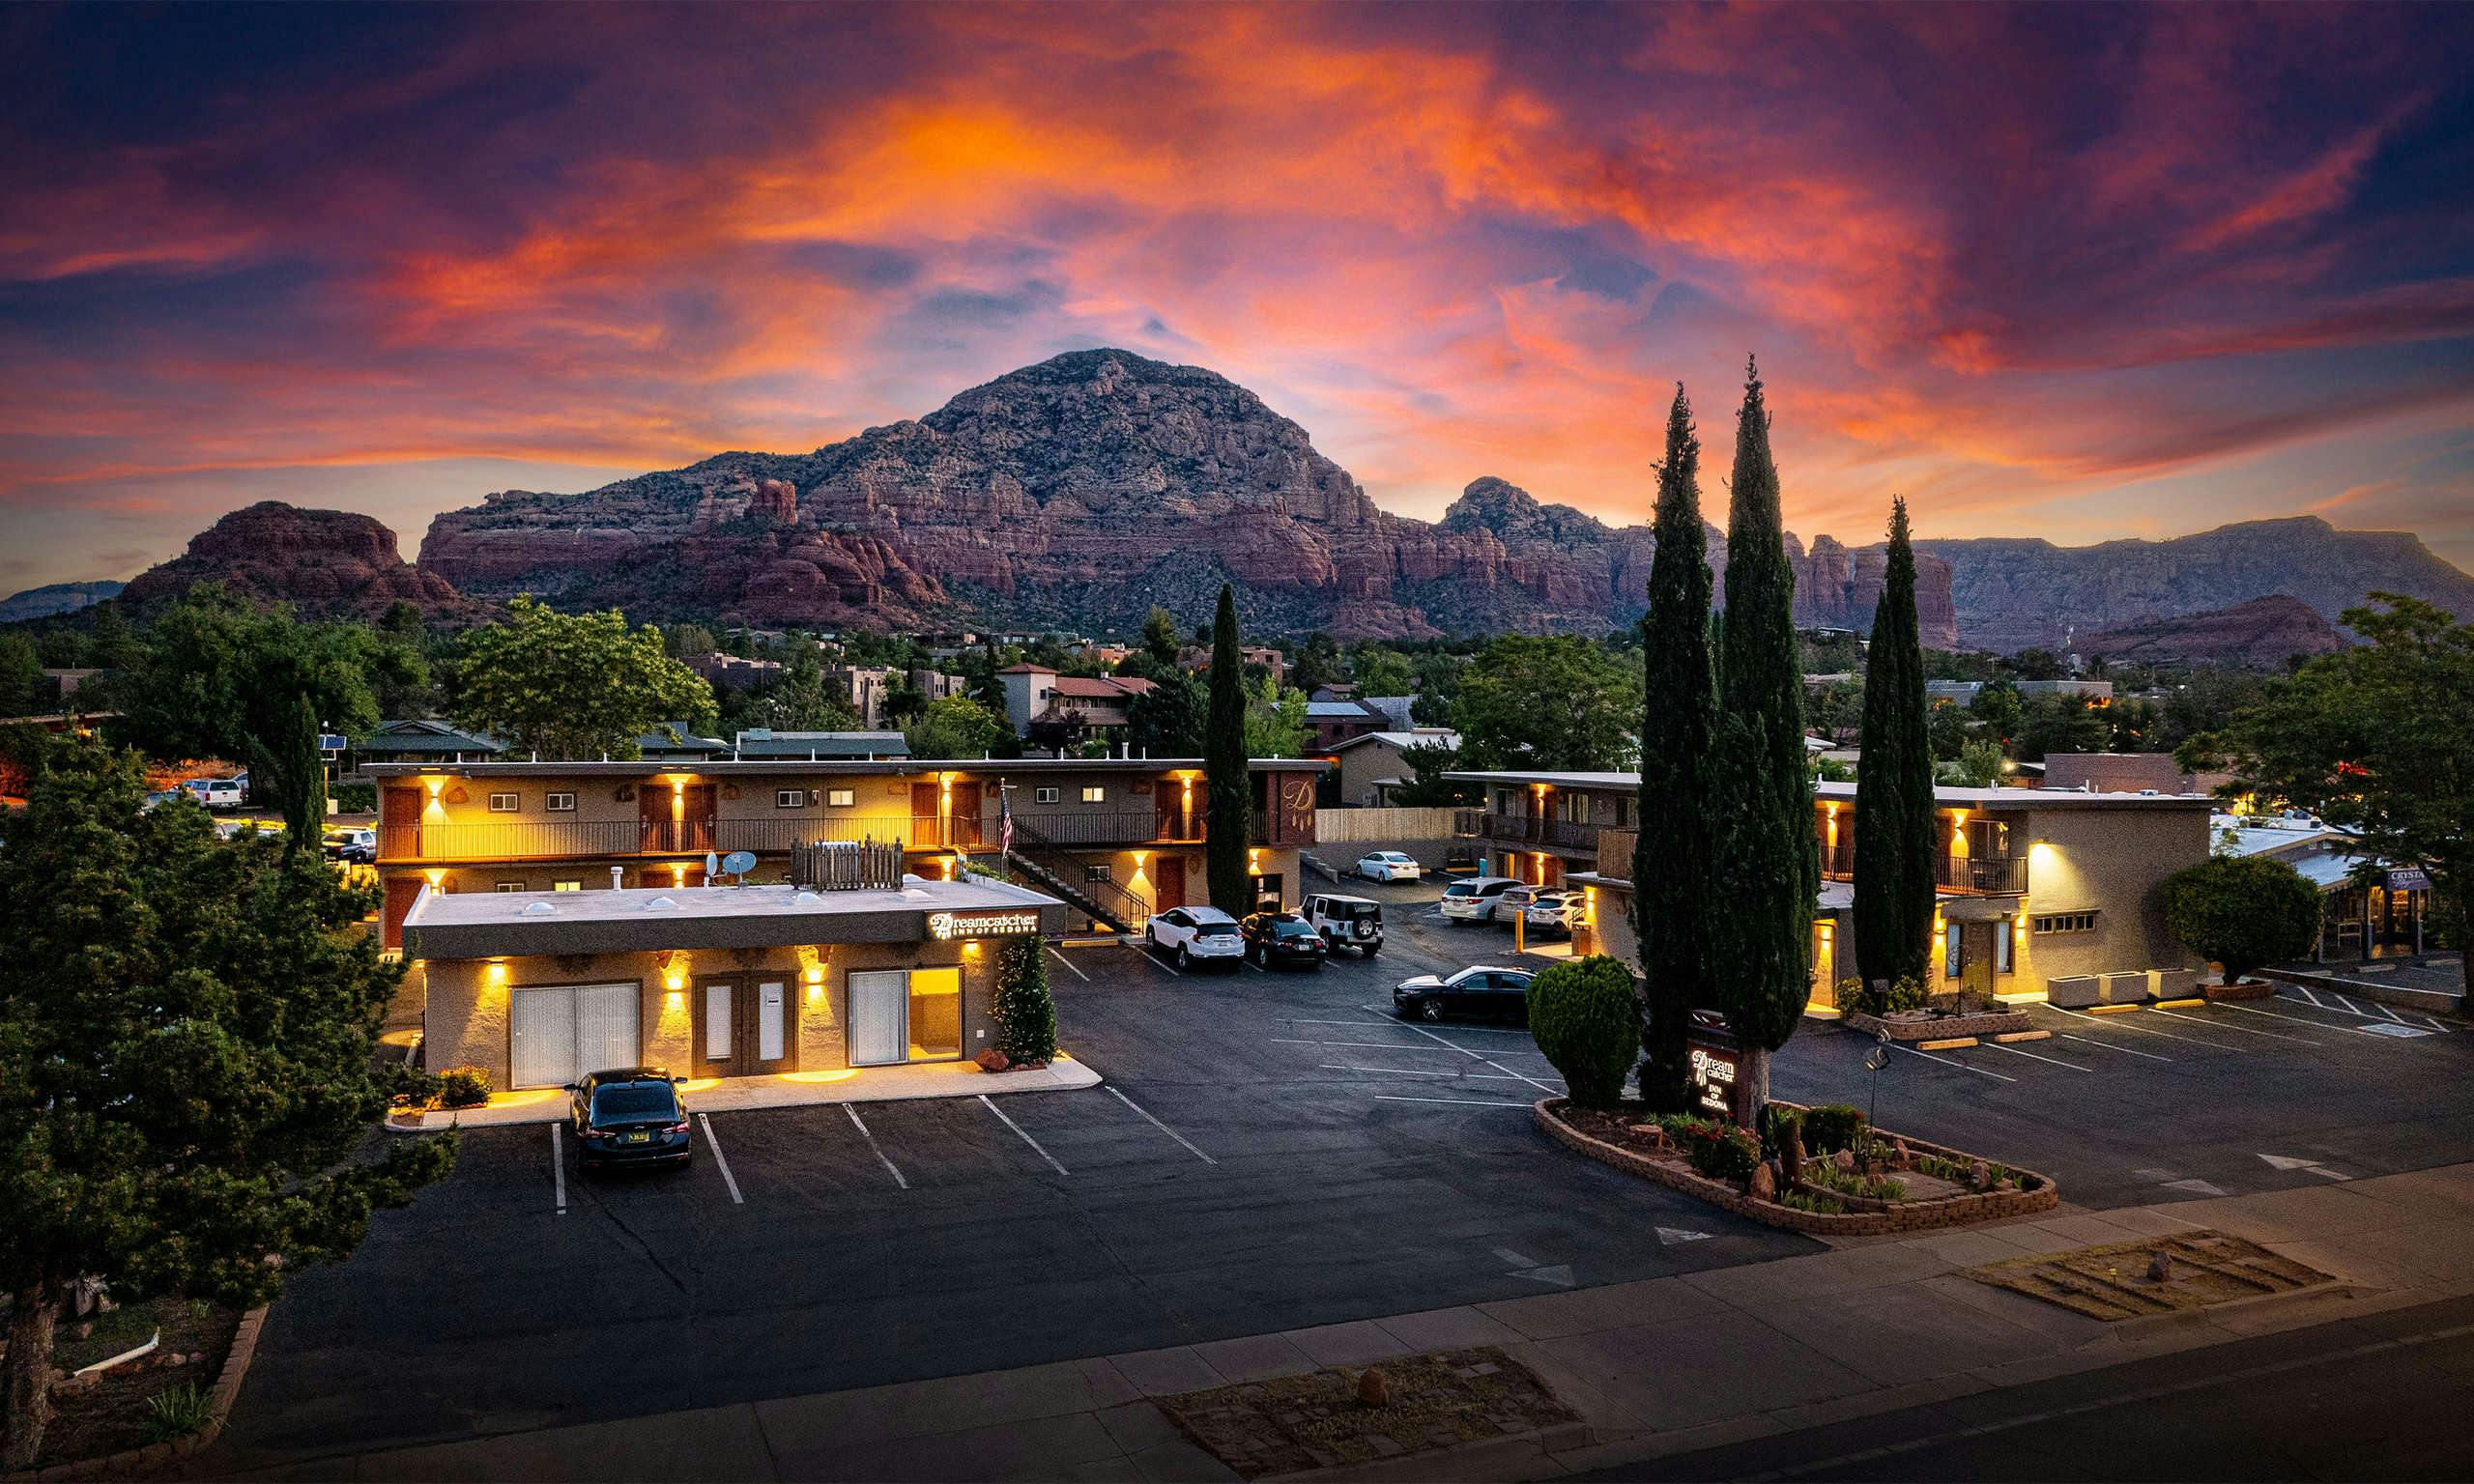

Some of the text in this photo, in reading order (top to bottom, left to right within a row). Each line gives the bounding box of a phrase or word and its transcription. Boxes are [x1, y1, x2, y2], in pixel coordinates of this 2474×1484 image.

[2391, 870, 2425, 879] CRYSTA
[930, 913, 1038, 929] Dreamcatcher
[1692, 1050, 1734, 1074] Dream
[1701, 1097, 1728, 1111] SEDONA
